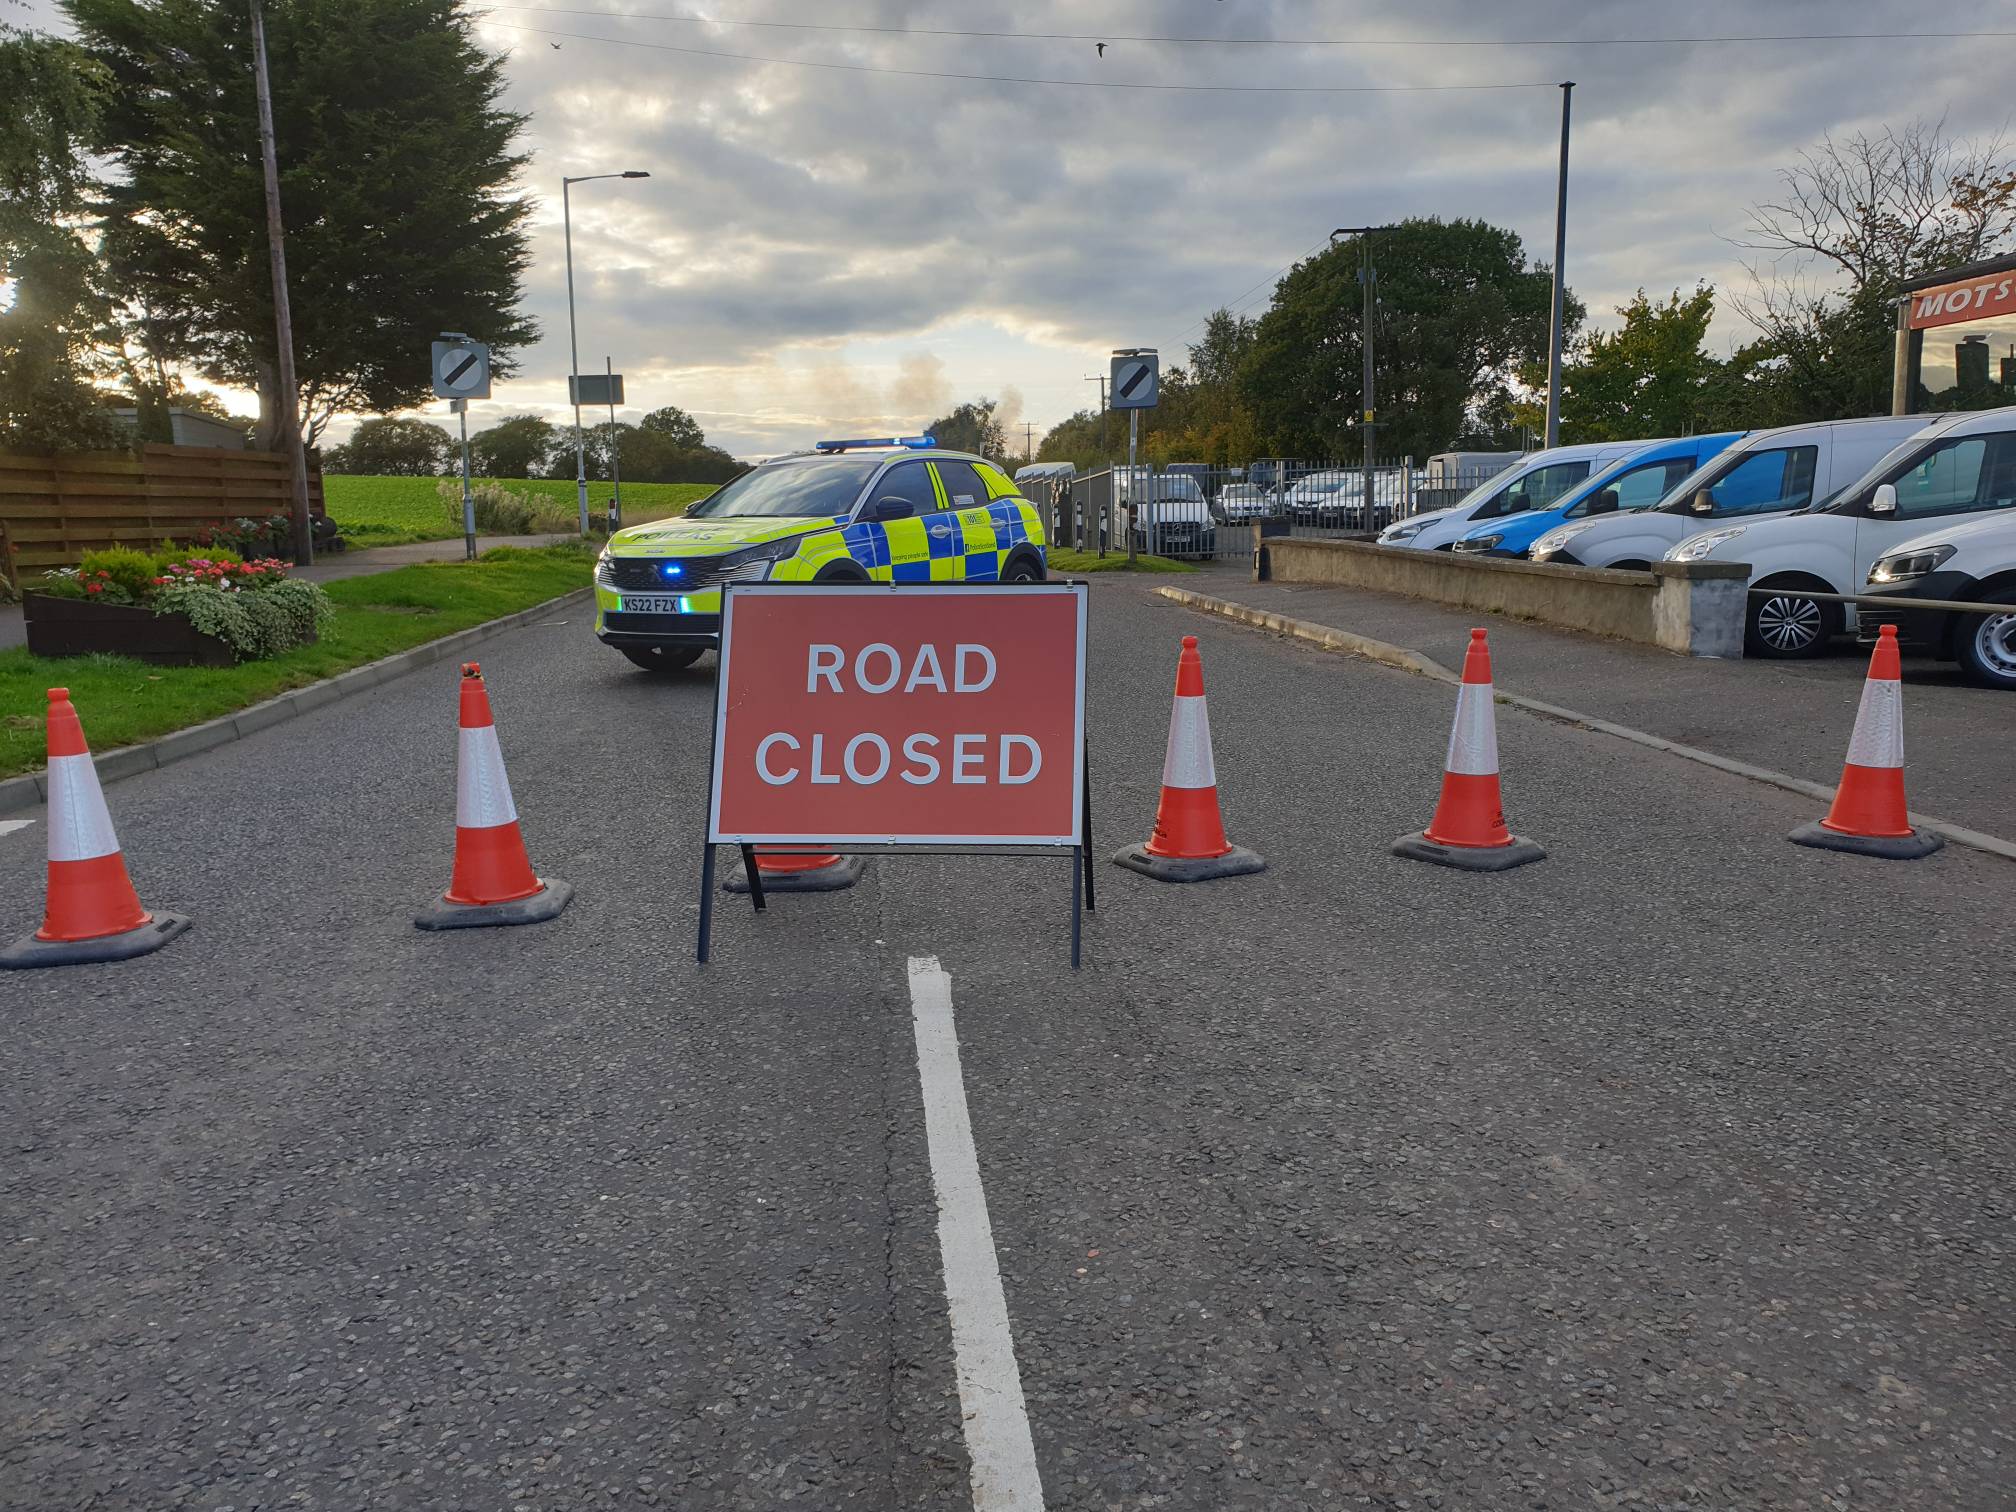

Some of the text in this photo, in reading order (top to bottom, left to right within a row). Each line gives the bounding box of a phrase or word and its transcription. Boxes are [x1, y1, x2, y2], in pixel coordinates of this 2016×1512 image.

[624, 598, 677, 612] KS22 FZX
[807, 642, 997, 693] ROAD
[755, 732, 1042, 785] CLOSED
